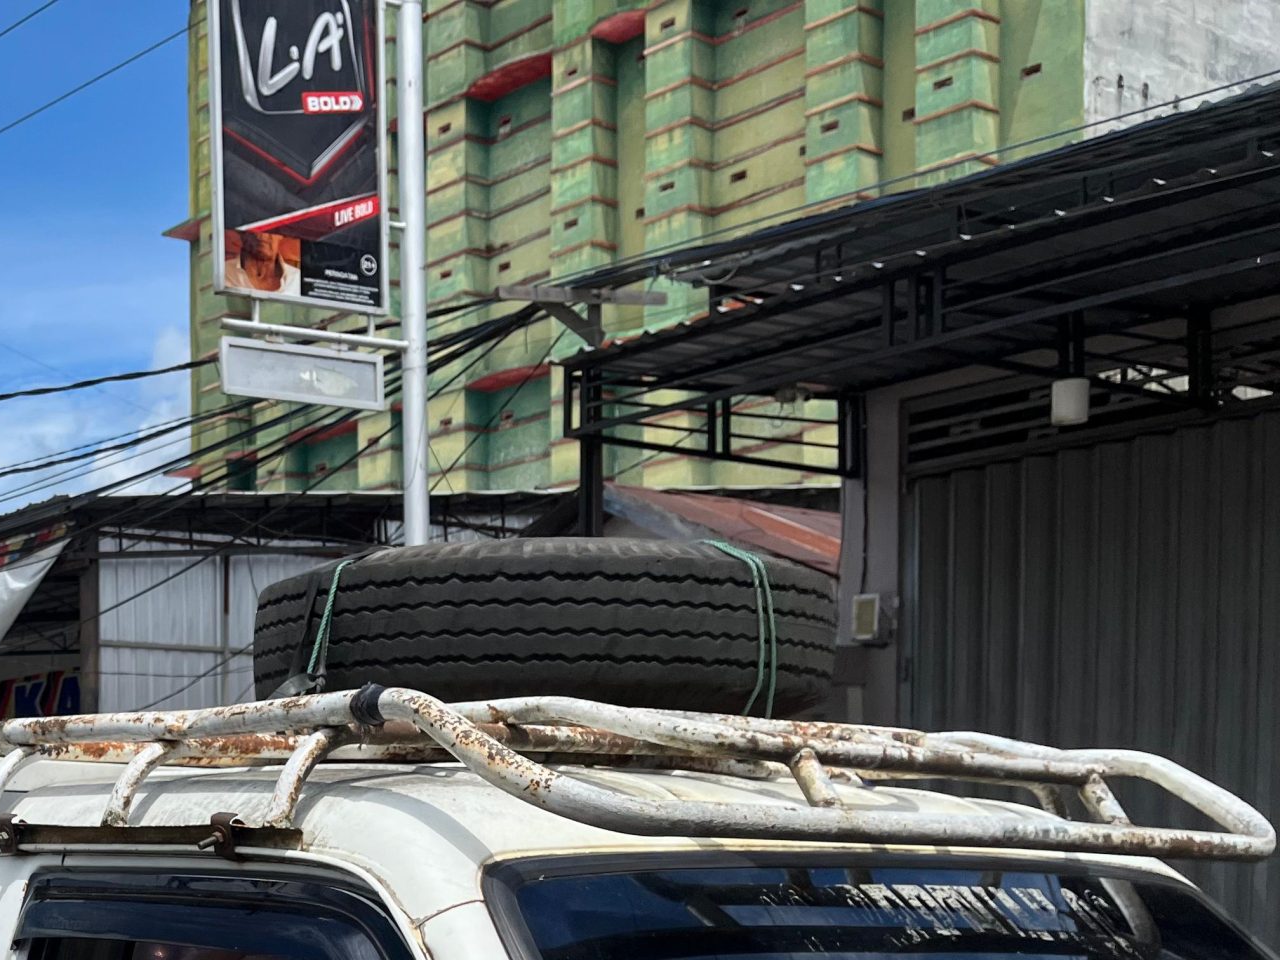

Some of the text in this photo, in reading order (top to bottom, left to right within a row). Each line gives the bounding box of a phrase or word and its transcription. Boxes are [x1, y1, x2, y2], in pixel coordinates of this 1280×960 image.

[307, 96, 350, 111] BOLD
[334, 200, 373, 227] LIVE BOLD
